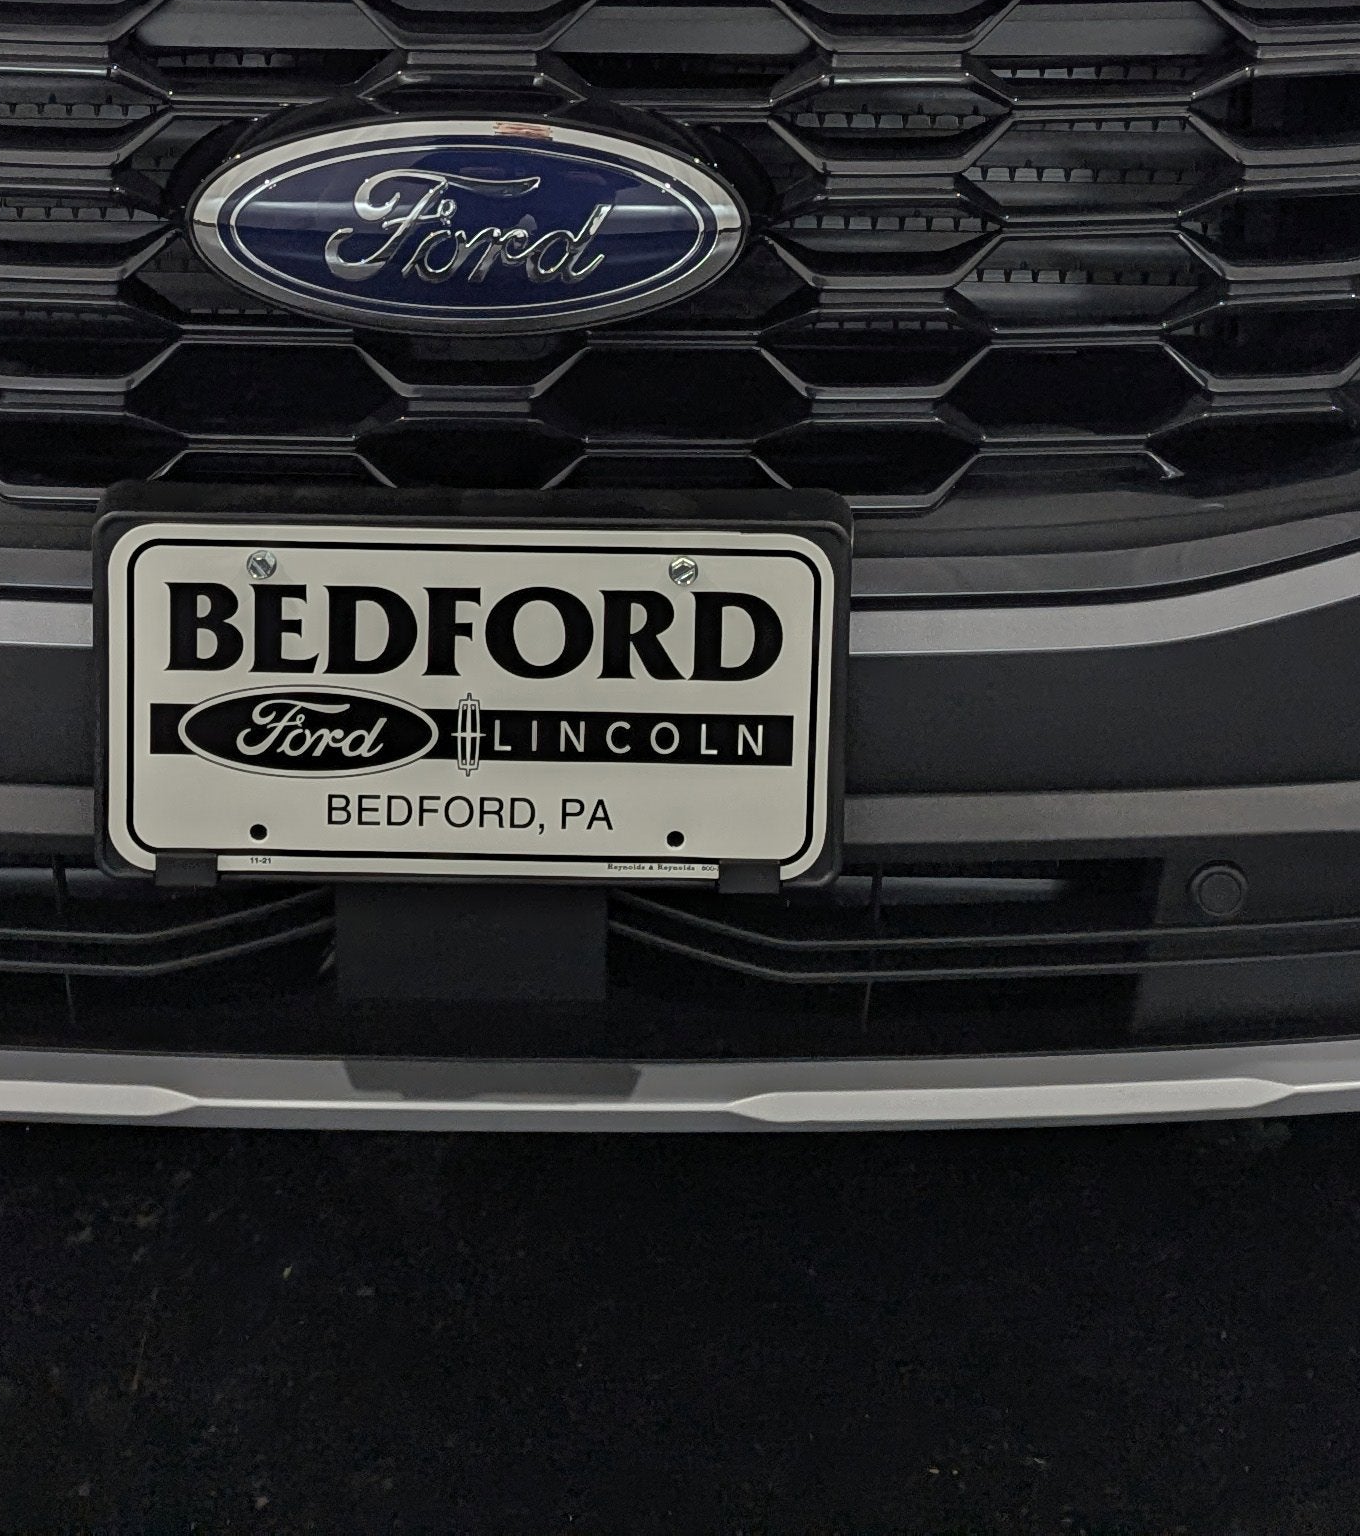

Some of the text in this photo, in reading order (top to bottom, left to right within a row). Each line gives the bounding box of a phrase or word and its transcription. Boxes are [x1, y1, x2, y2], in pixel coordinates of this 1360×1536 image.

[324, 169, 614, 284] Ford
[164, 582, 783, 682] BEDFORD
[236, 699, 388, 758] Ford
[494, 720, 764, 757] LINCOLN
[328, 794, 614, 835] BEDFORD, PA
[607, 863, 646, 872] Reynolds
[657, 863, 696, 873] Reynolds
